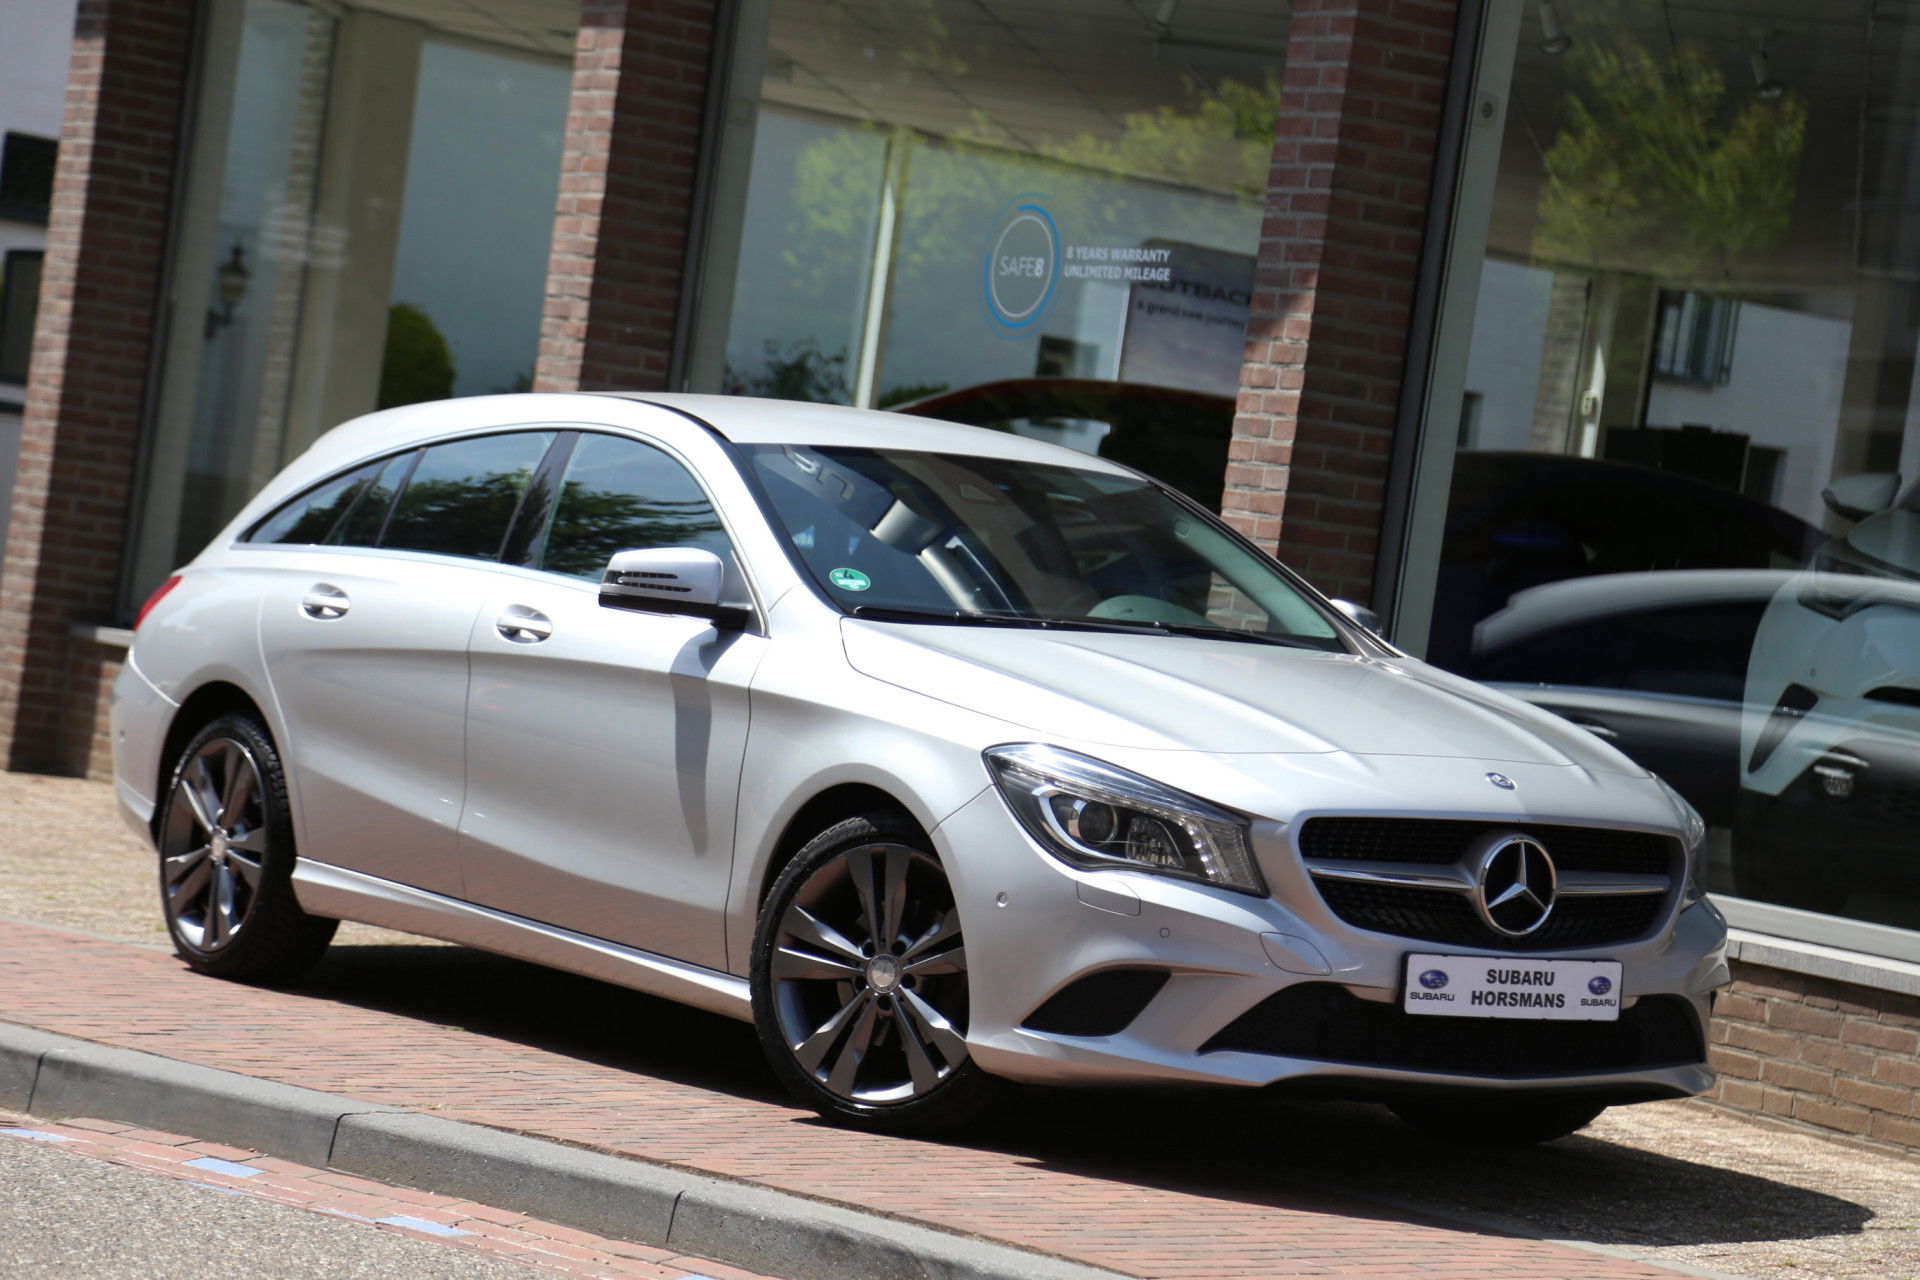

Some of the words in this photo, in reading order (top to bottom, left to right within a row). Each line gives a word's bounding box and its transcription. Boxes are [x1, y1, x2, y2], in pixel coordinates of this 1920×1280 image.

[1066, 246, 1075, 260] 8
[1077, 247, 1108, 262] YEARS
[1111, 248, 1171, 263] WARRANTY
[1000, 255, 1045, 277] SAFE8
[1064, 264, 1121, 280] UNLIMITED
[1124, 267, 1171, 282] MILEAGE
[1146, 303, 1179, 317] grand
[1182, 309, 1203, 320] new
[1486, 968, 1555, 987] SUBARU
[1409, 991, 1455, 1002] SUBARU
[1470, 990, 1566, 1009] HORSMANS
[1580, 998, 1616, 1008] SUBARU
